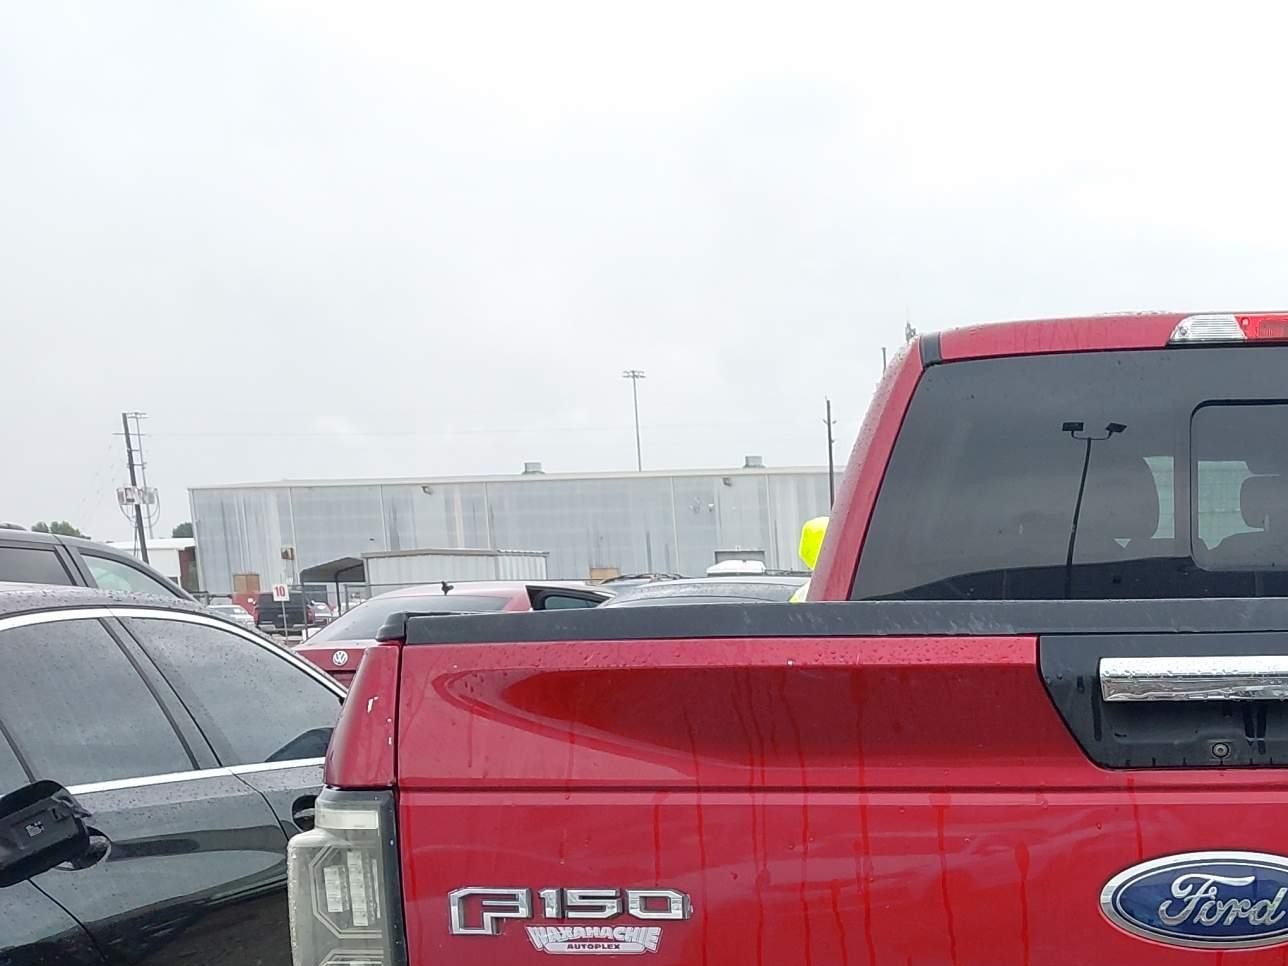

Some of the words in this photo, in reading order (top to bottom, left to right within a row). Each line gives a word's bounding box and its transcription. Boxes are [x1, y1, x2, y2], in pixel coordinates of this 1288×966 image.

[274, 586, 286, 598] 10
[1158, 873, 1288, 926] Ford
[526, 926, 662, 951] WAXAHACHIE
